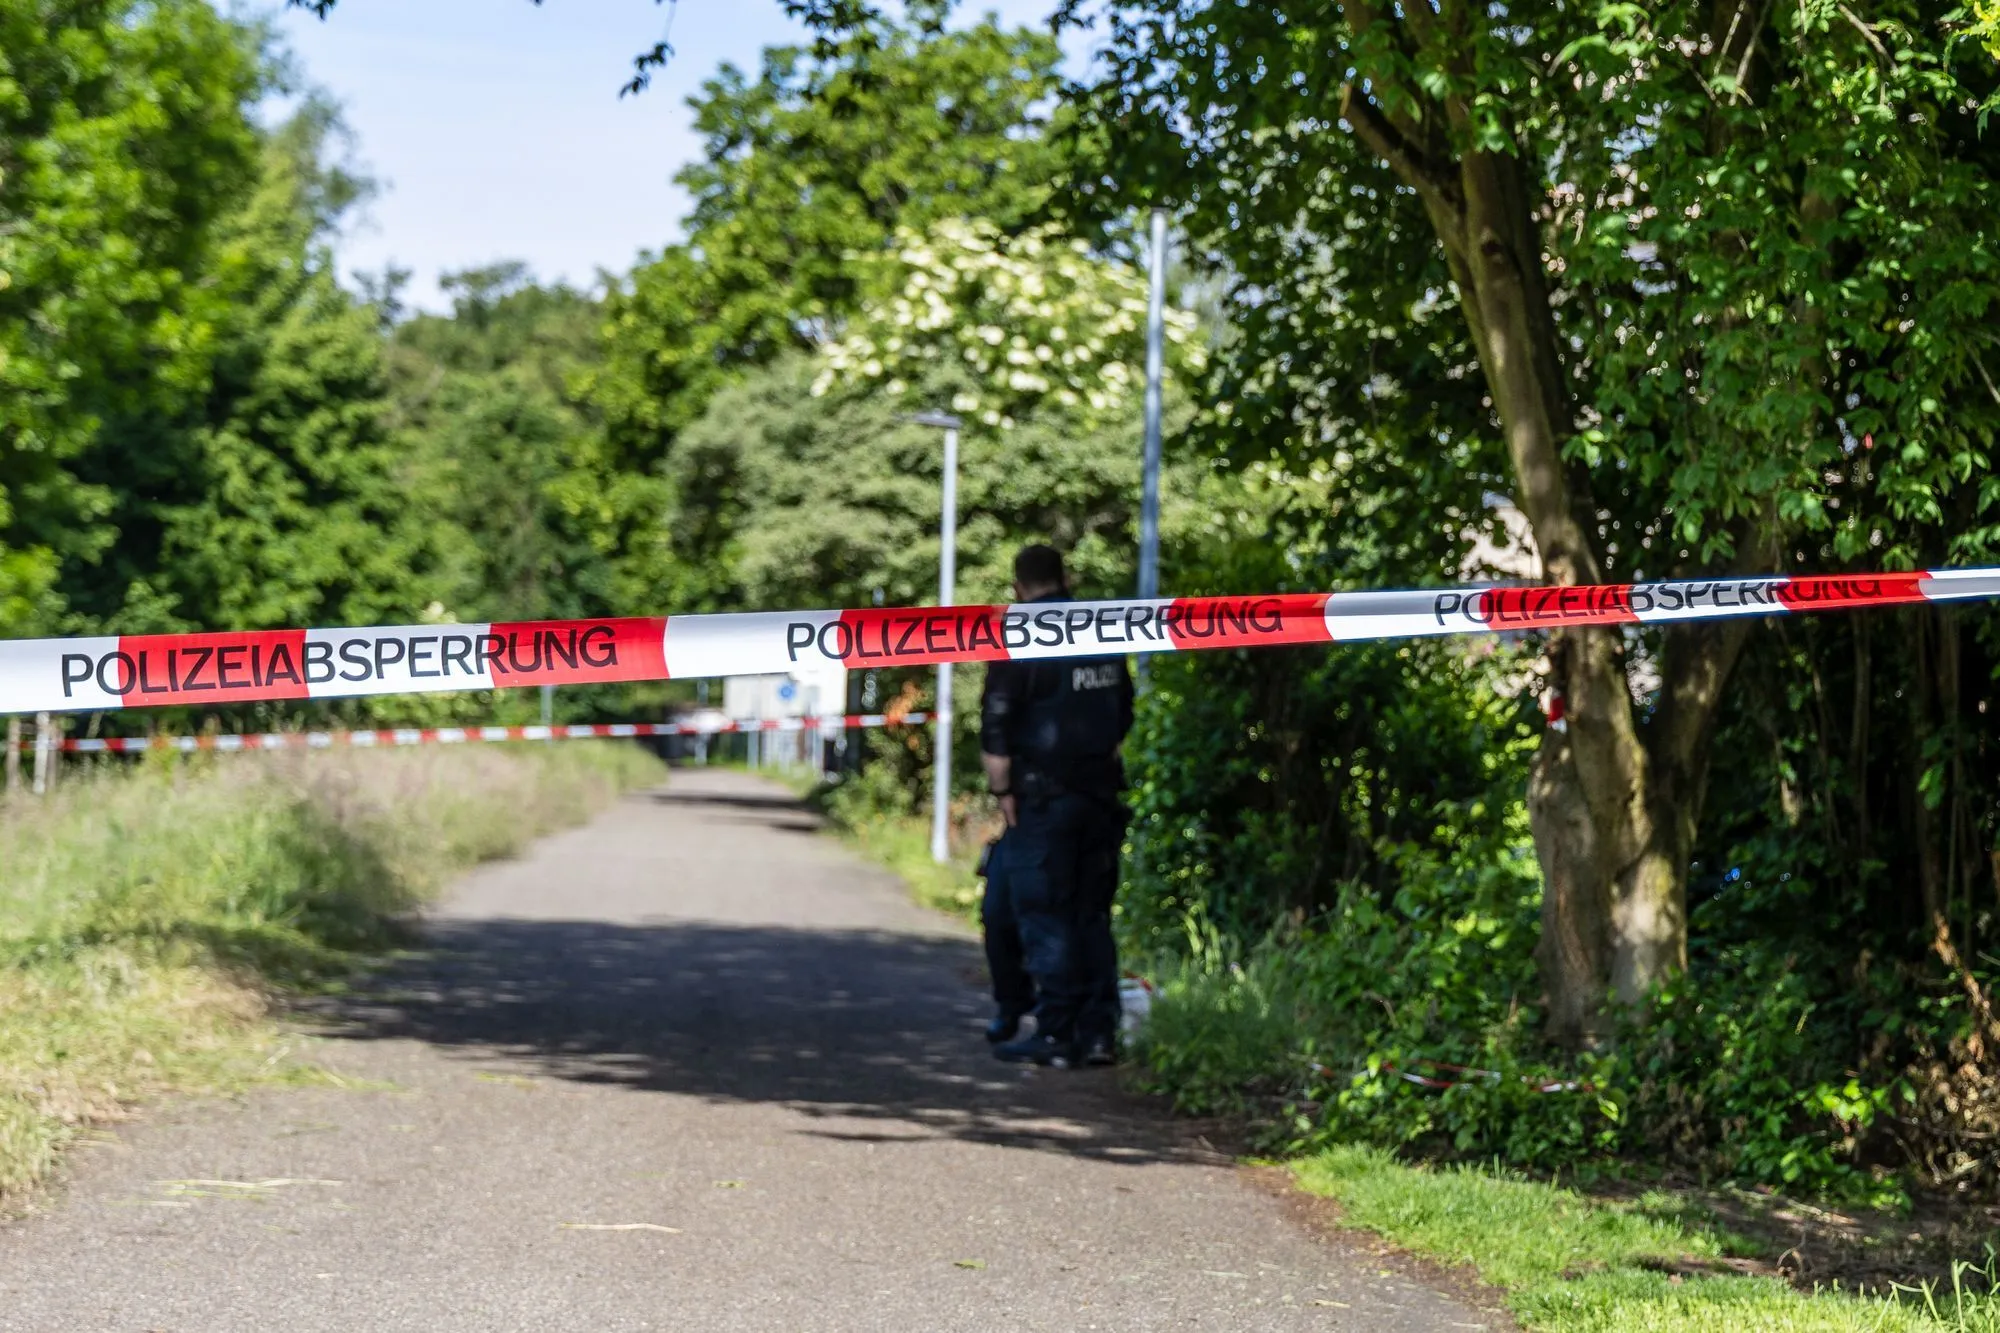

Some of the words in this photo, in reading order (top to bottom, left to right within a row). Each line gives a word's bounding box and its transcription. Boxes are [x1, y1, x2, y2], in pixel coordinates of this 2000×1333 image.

[787, 598, 1283, 661] POLIZEIABSPERRUNG
[1434, 579, 1882, 626] POLIZEIABSPERRUNG
[62, 625, 618, 697] POLIZEIABSPERRUNG
[1072, 664, 1120, 691] POLIZ
